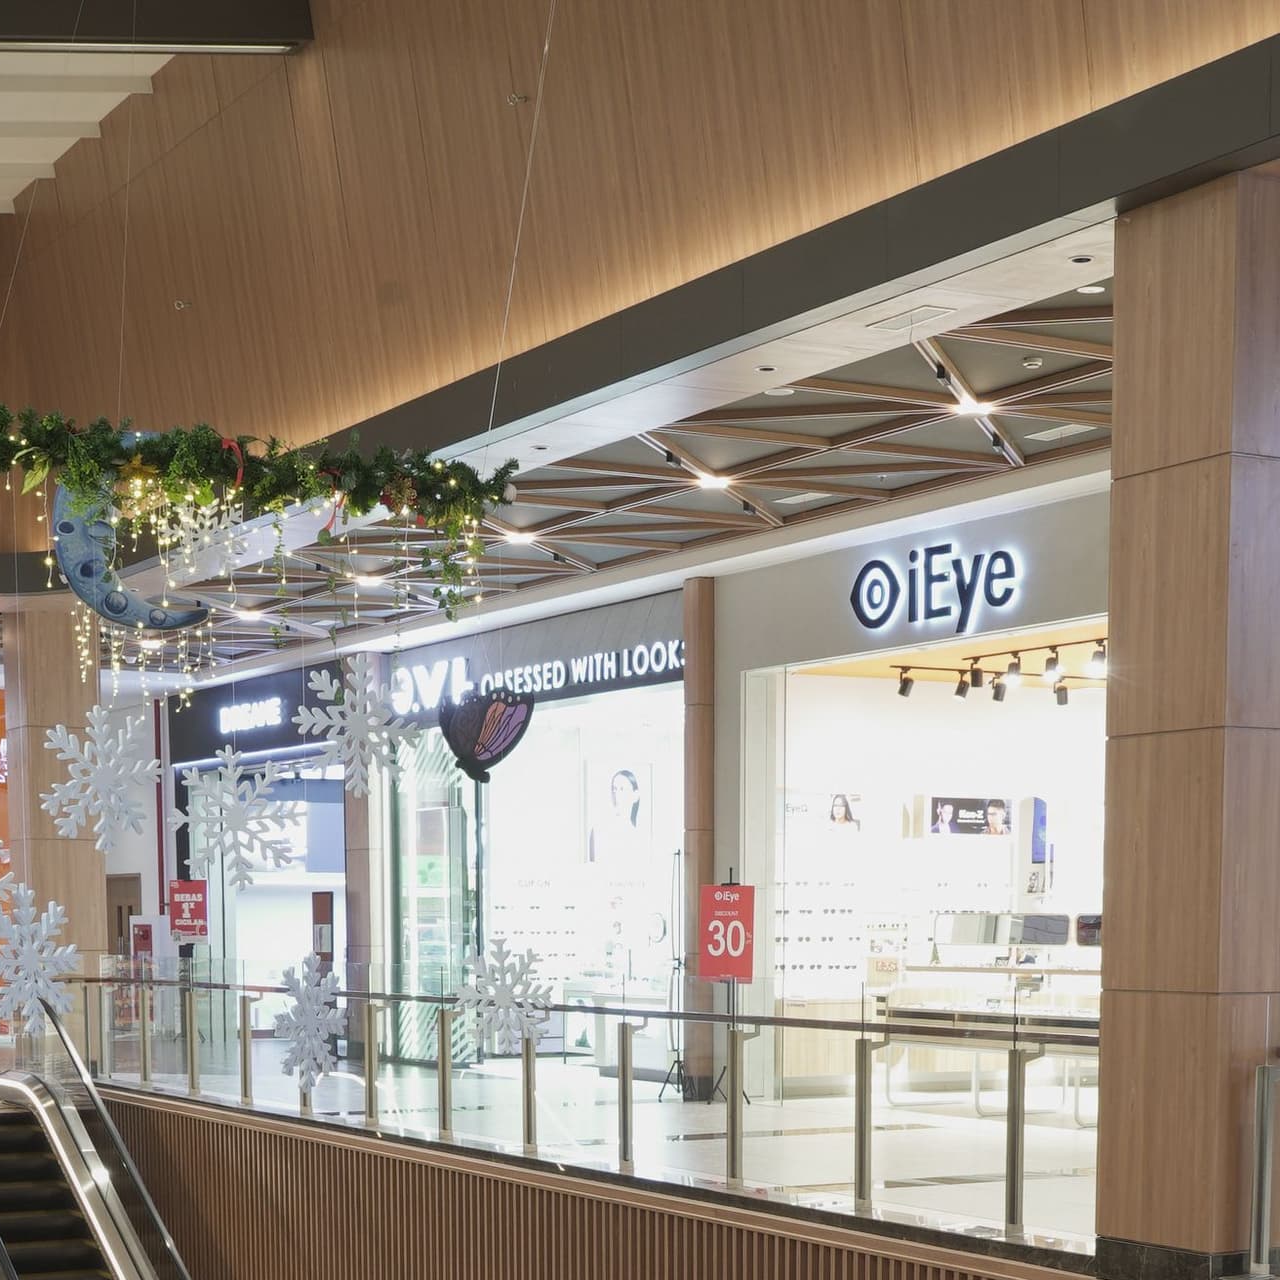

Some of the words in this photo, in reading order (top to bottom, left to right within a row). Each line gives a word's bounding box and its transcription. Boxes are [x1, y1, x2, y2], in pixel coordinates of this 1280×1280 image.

[908, 543, 1016, 633] iEye
[481, 660, 566, 697] OBSESSED
[571, 651, 617, 684] WITH
[707, 920, 746, 957] 30
